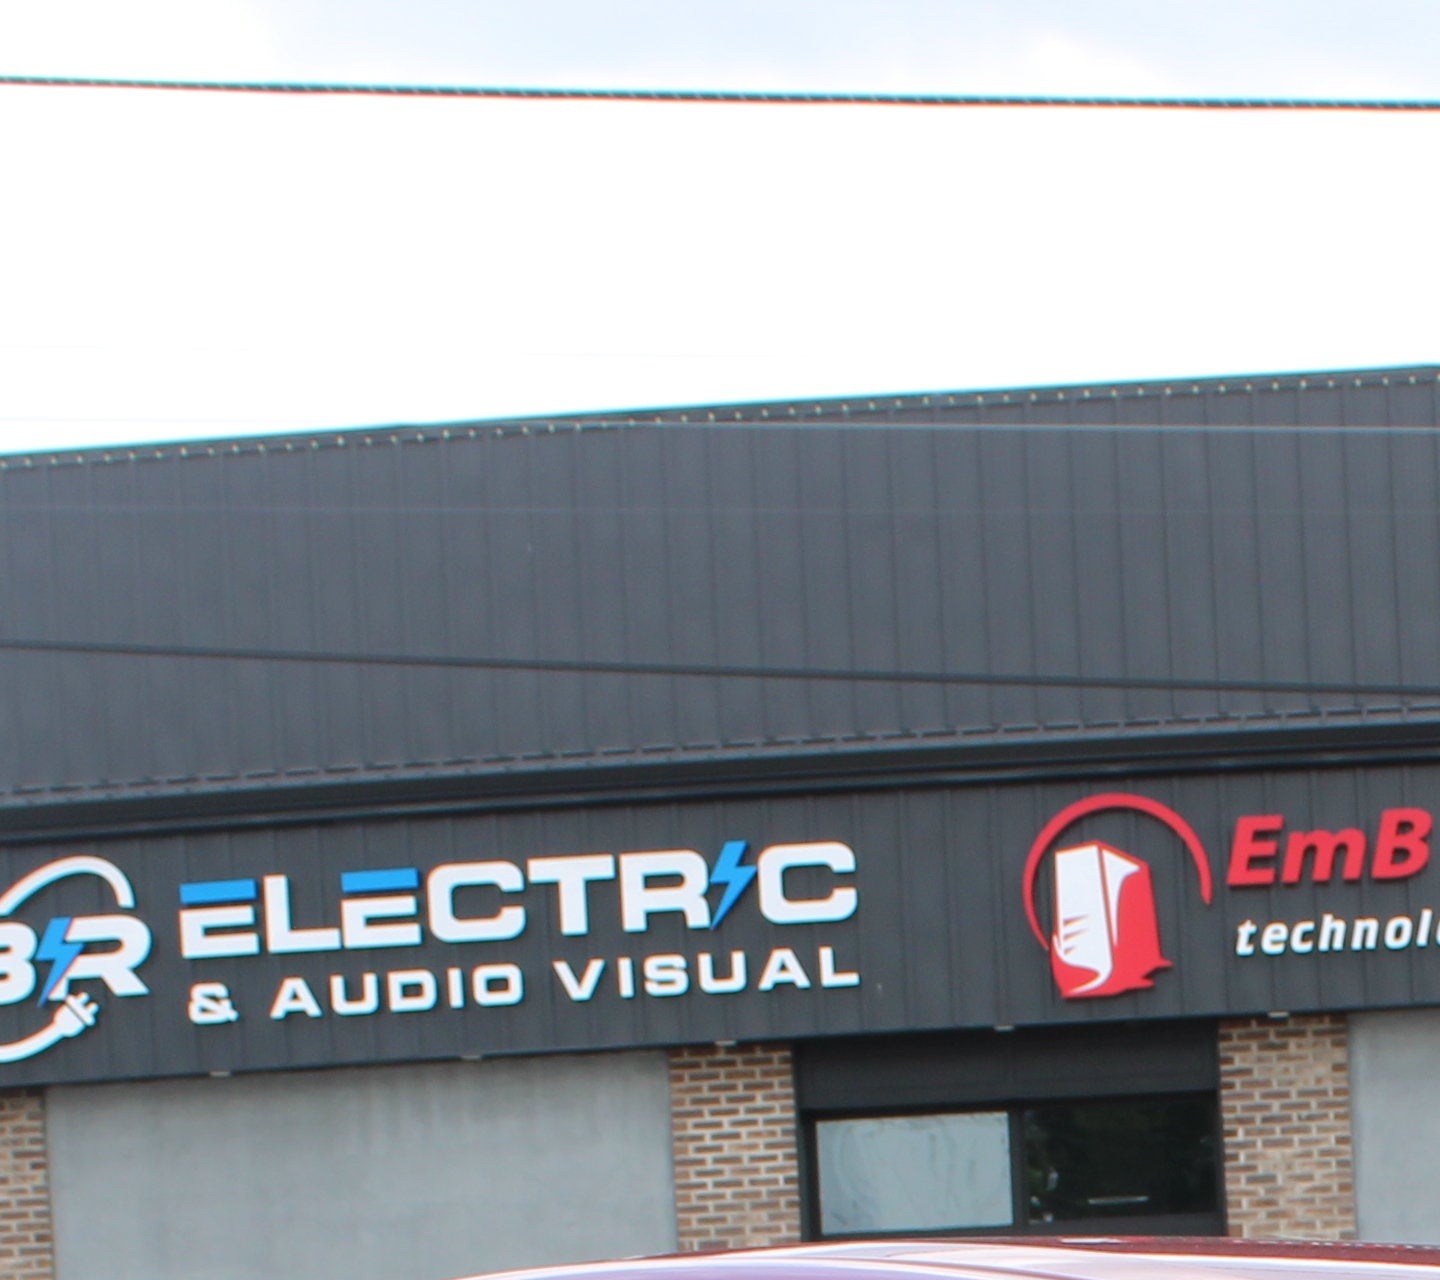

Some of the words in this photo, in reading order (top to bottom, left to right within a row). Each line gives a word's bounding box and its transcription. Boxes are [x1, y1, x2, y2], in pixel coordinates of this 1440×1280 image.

[1226, 806, 1434, 888] EmB
[178, 840, 857, 960] ELECTRIC
[188, 981, 239, 1025] &
[270, 962, 525, 1020] AUDIO
[553, 946, 860, 1001] VISUAL
